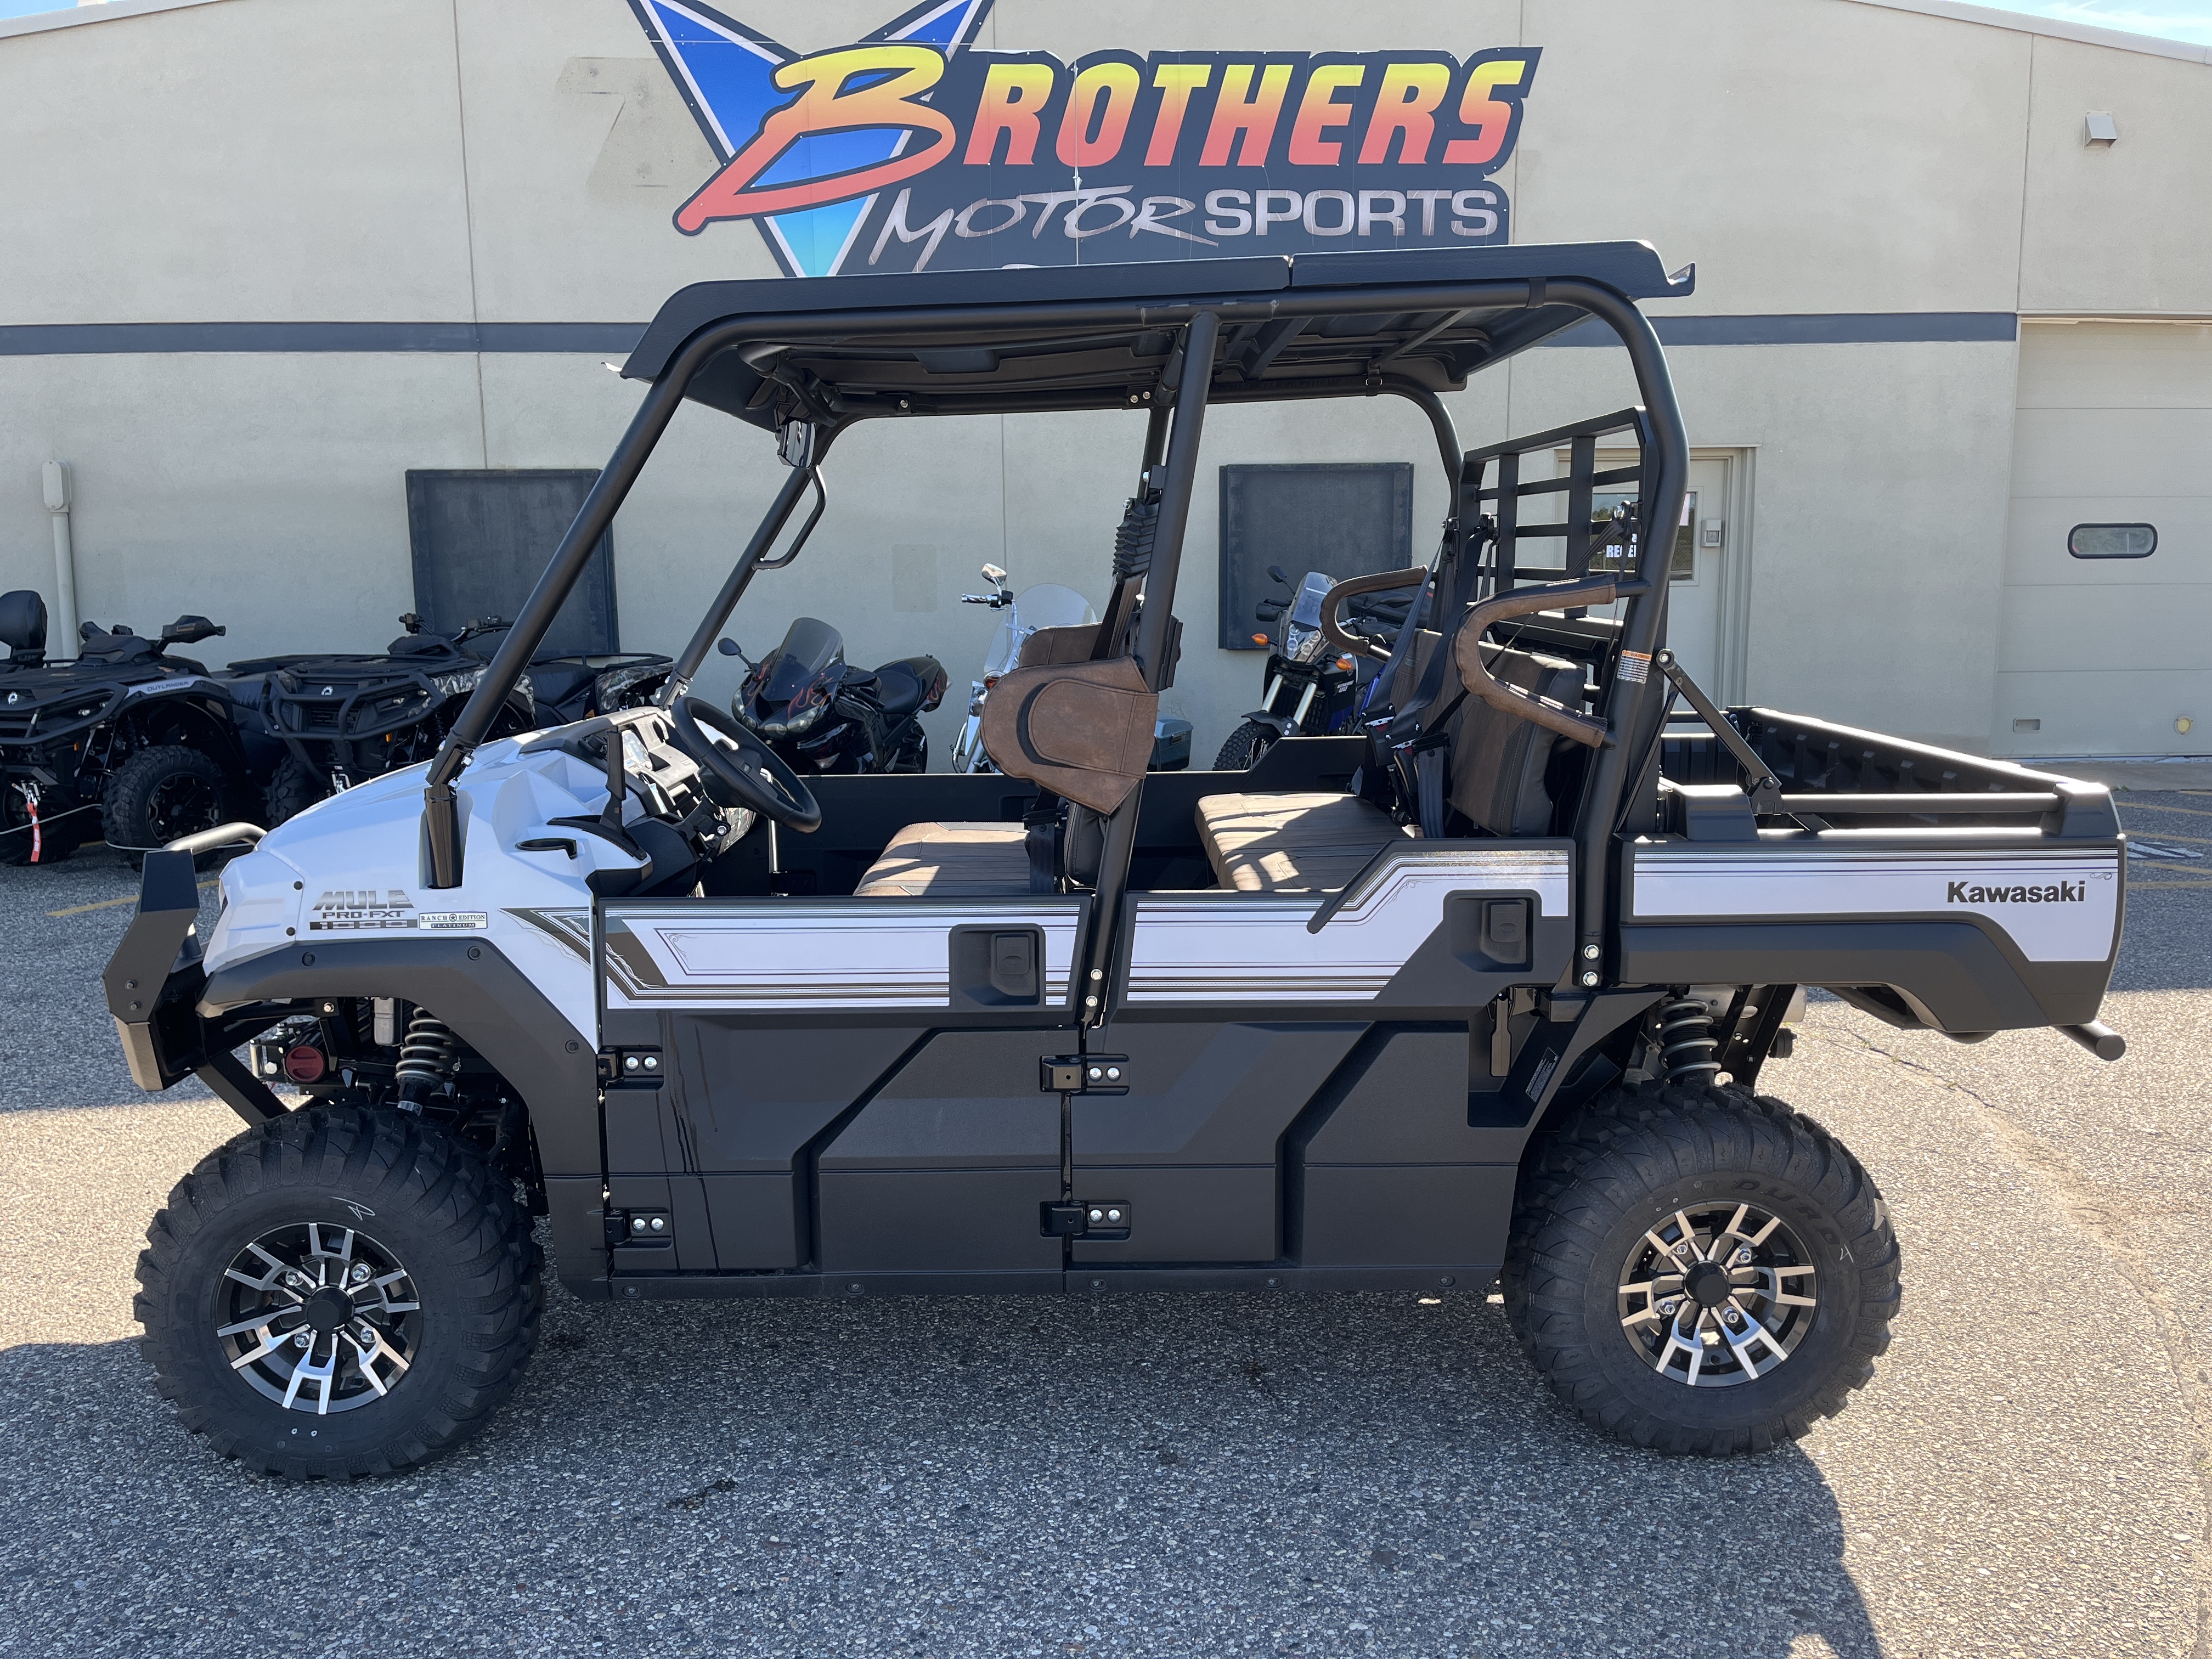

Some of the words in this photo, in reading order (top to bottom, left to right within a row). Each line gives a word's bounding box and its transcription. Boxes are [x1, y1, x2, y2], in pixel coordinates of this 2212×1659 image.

[677, 46, 1527, 231] BROTHERS
[147, 681, 189, 692] OUTLANDER
[1948, 881, 2085, 903] Kawasaki
[312, 890, 415, 911] MULE
[323, 910, 405, 919] PRO-FXT
[319, 921, 408, 930] 1000
